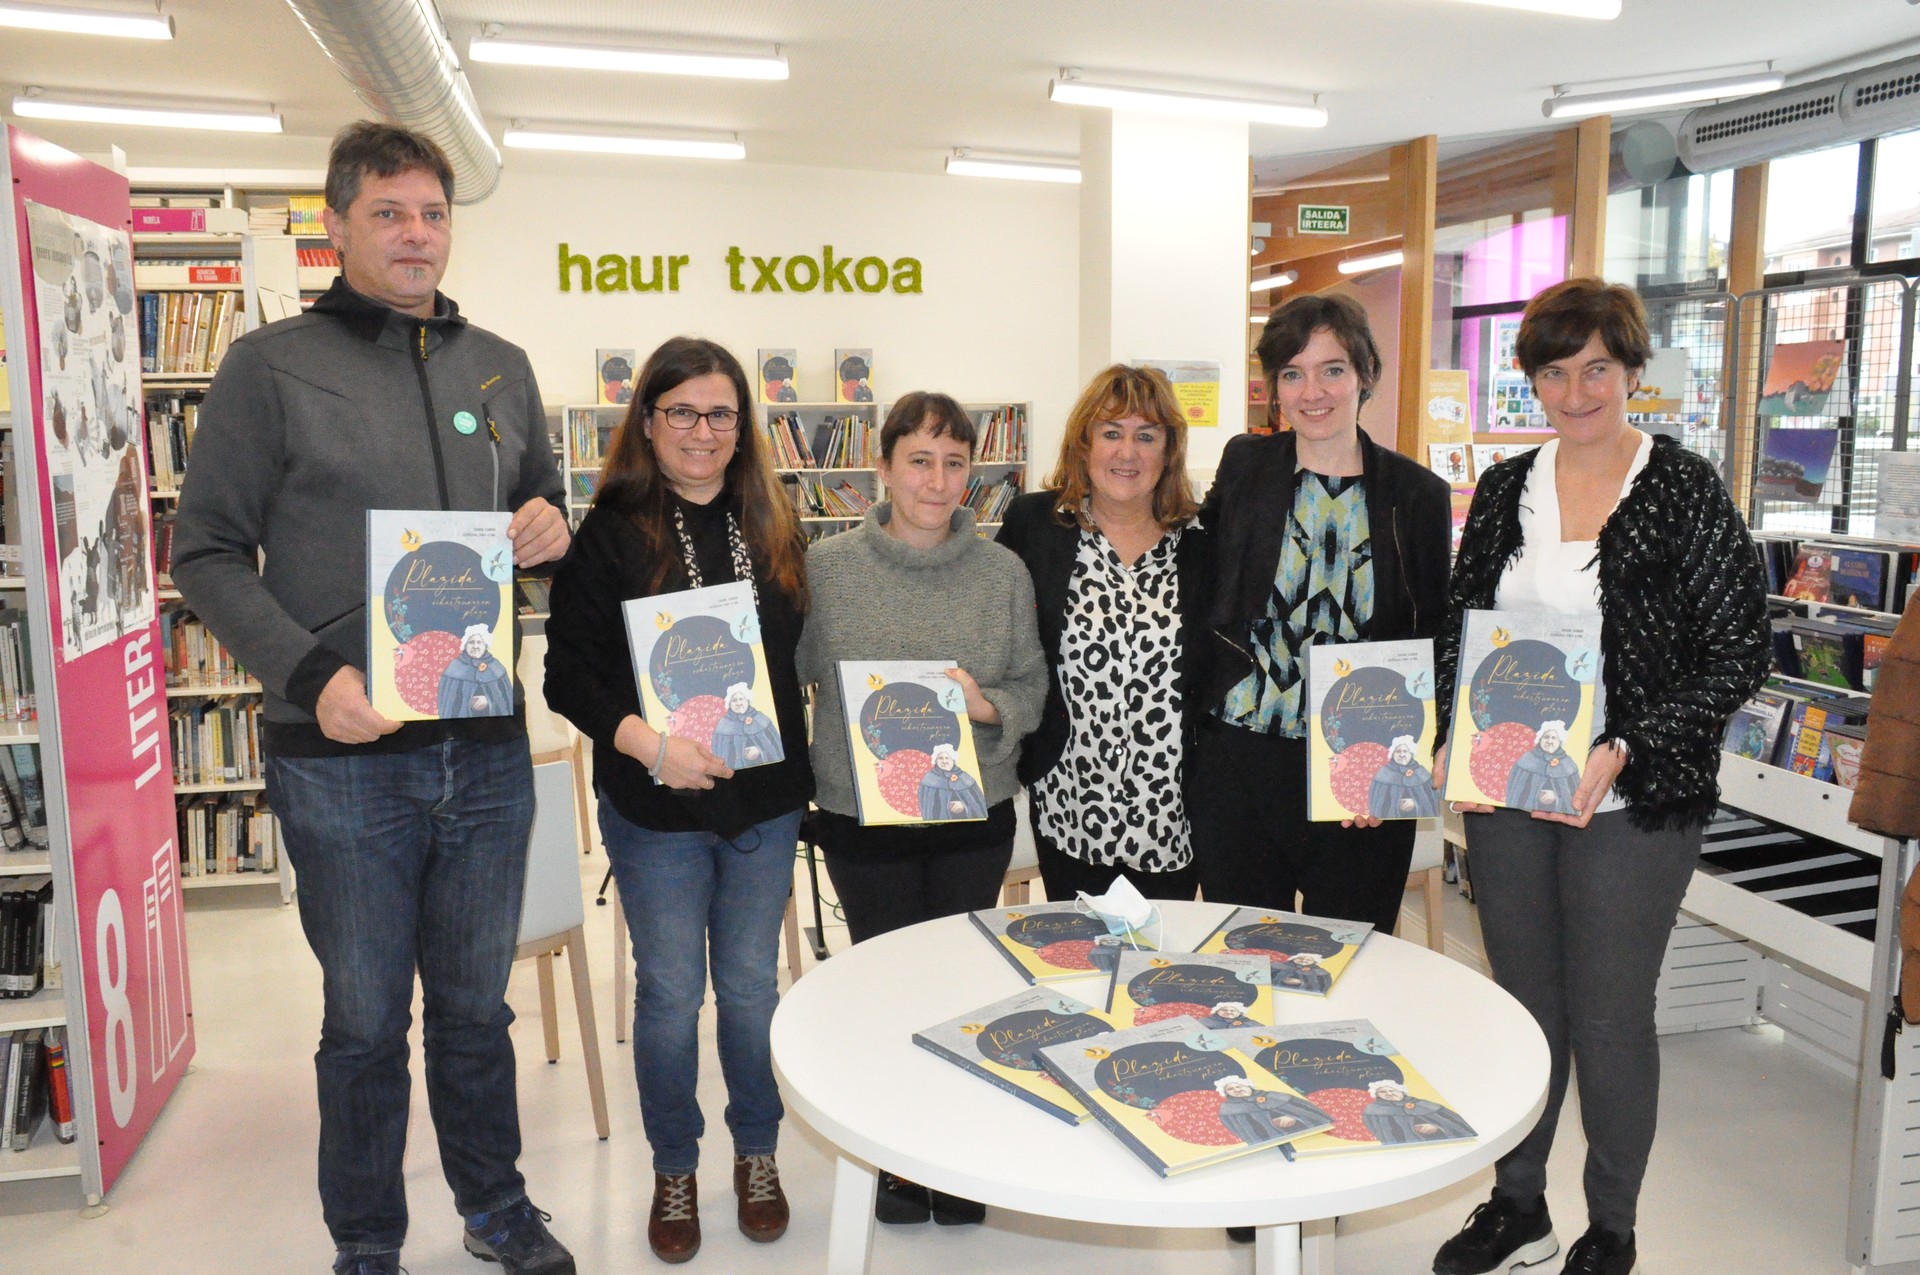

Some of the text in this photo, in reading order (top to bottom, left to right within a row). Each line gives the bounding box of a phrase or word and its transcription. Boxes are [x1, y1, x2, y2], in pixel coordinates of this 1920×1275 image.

[1302, 219, 1344, 230] IRTEERA
[1305, 209, 1341, 220] SALIDA
[558, 242, 923, 294] haur txokoa
[402, 559, 477, 595] Plazida
[664, 634, 727, 667] Plazida
[1488, 654, 1558, 690] Plazida
[874, 695, 935, 722] Plazida
[1336, 682, 1400, 713] Plazida
[96, 888, 137, 1129] 8
[989, 1016, 1057, 1051] Plazida
[1112, 1050, 1189, 1082] Plazida
[1273, 1050, 1353, 1070] Plazida
